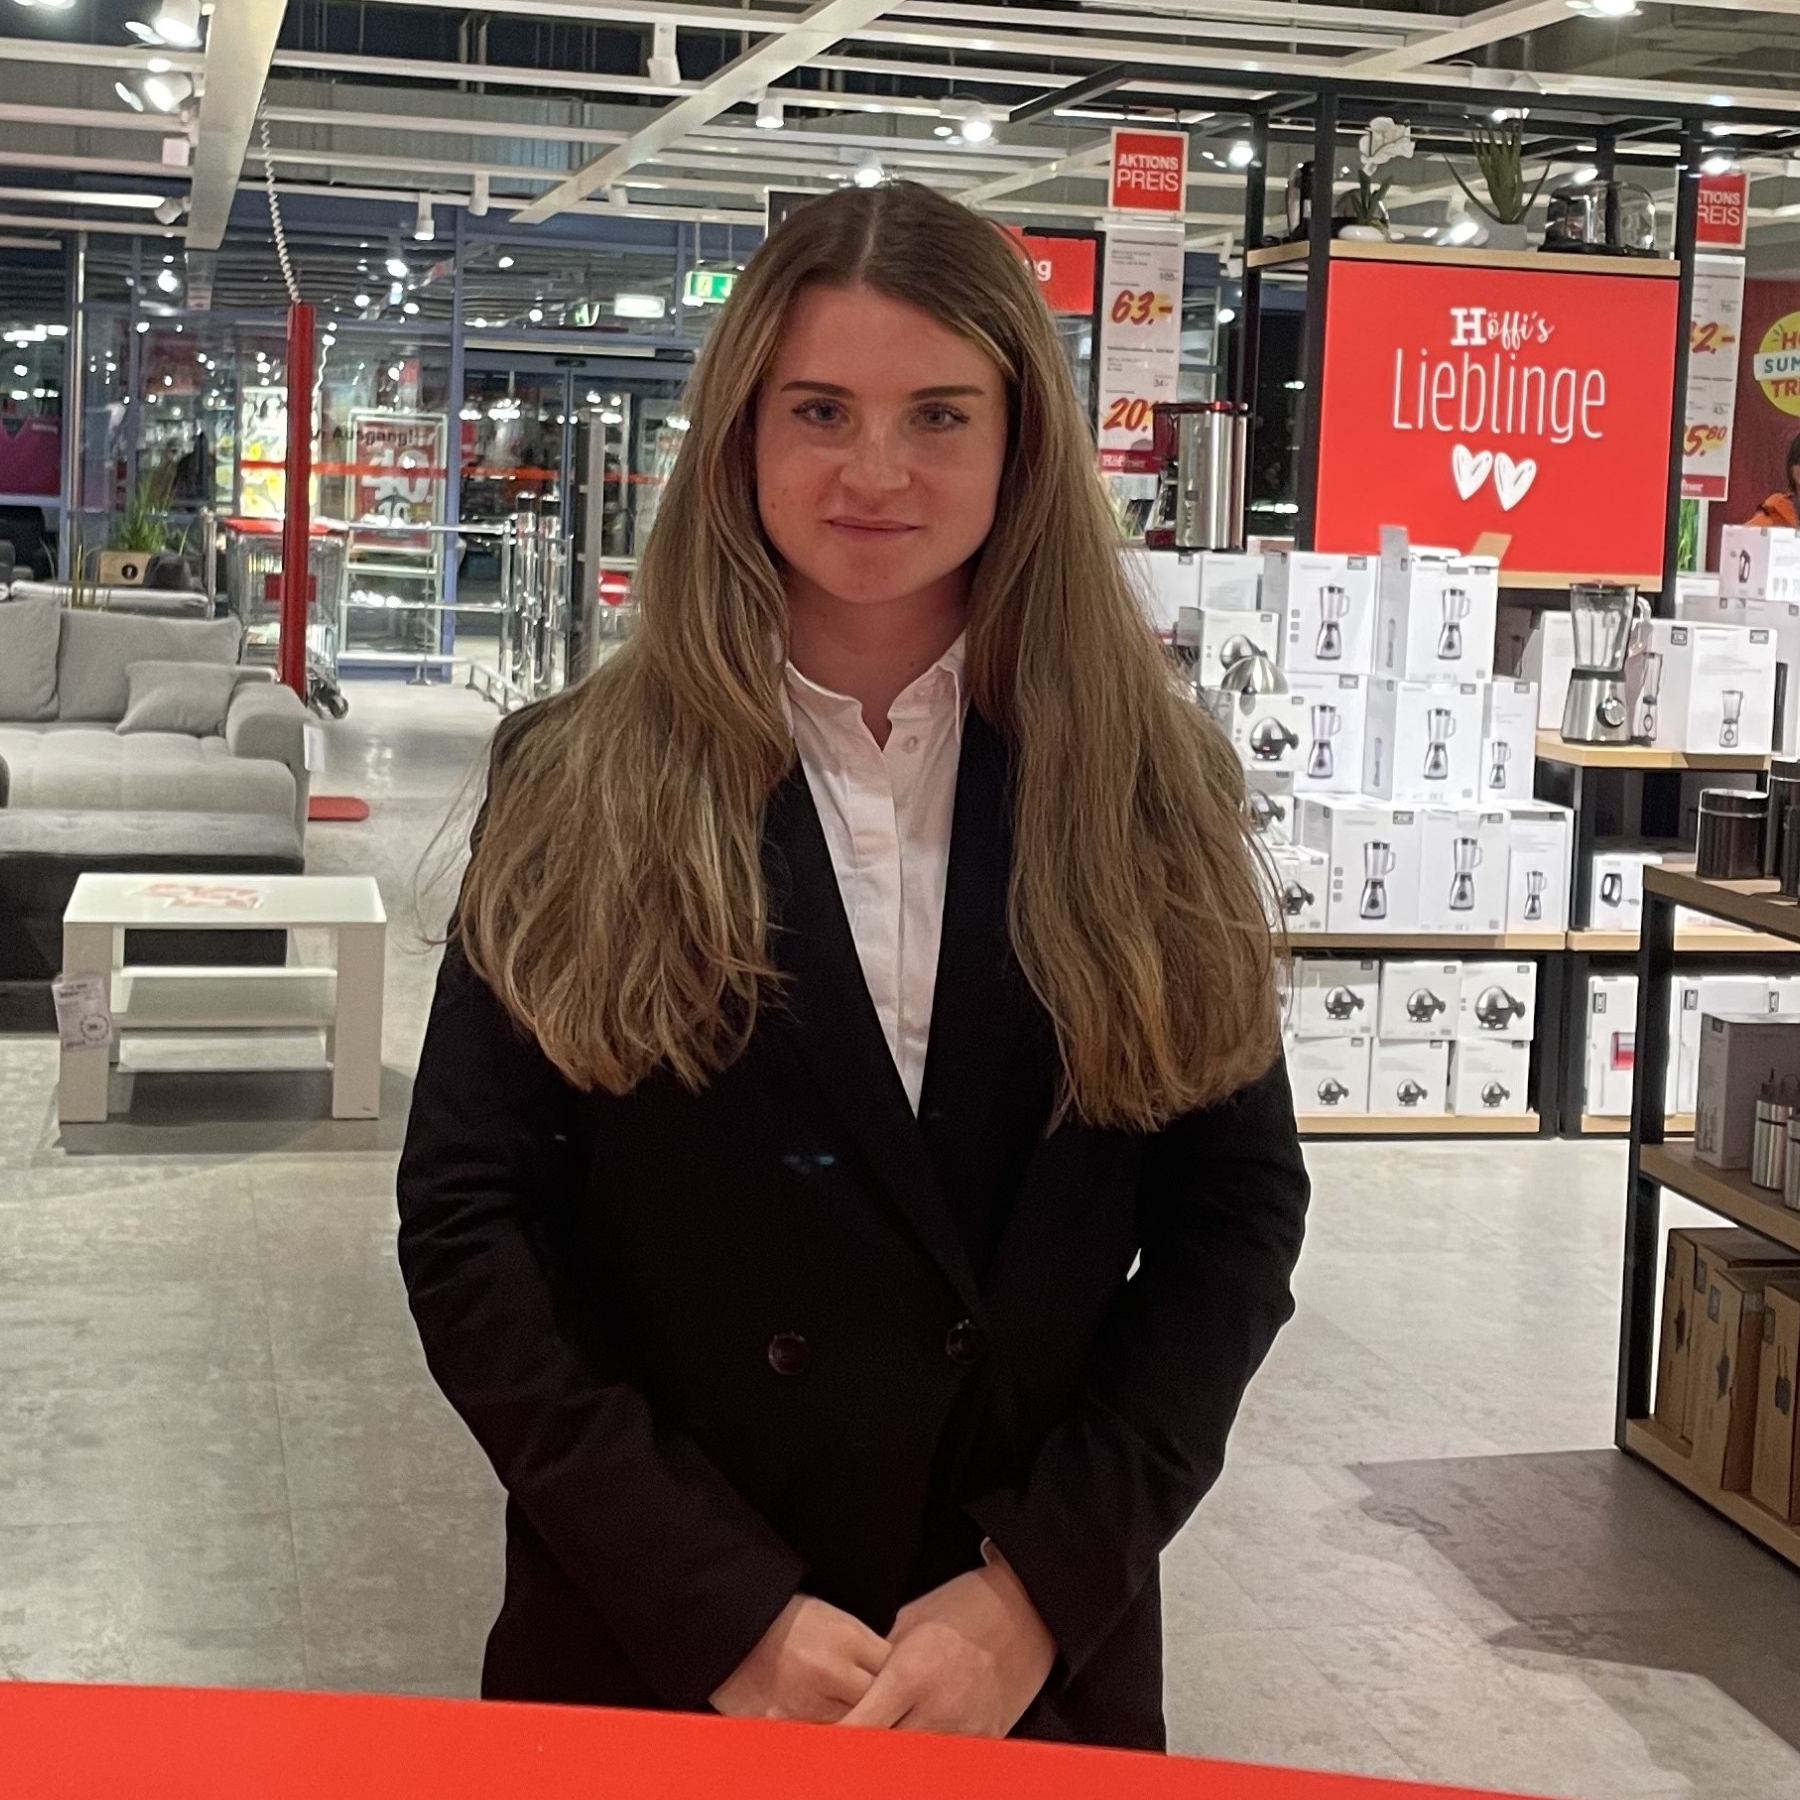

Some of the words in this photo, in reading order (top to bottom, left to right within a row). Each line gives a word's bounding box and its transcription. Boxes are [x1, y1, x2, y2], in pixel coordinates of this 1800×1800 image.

[1118, 153, 1179, 171] AKTIONS
[1116, 168, 1179, 192] PREIS
[1698, 189, 1741, 206] TIONS
[1781, 331, 1800, 351] H
[1393, 347, 1606, 444] Lieblinge
[1771, 379, 1800, 399] TR
[1102, 397, 1154, 433] 20.
